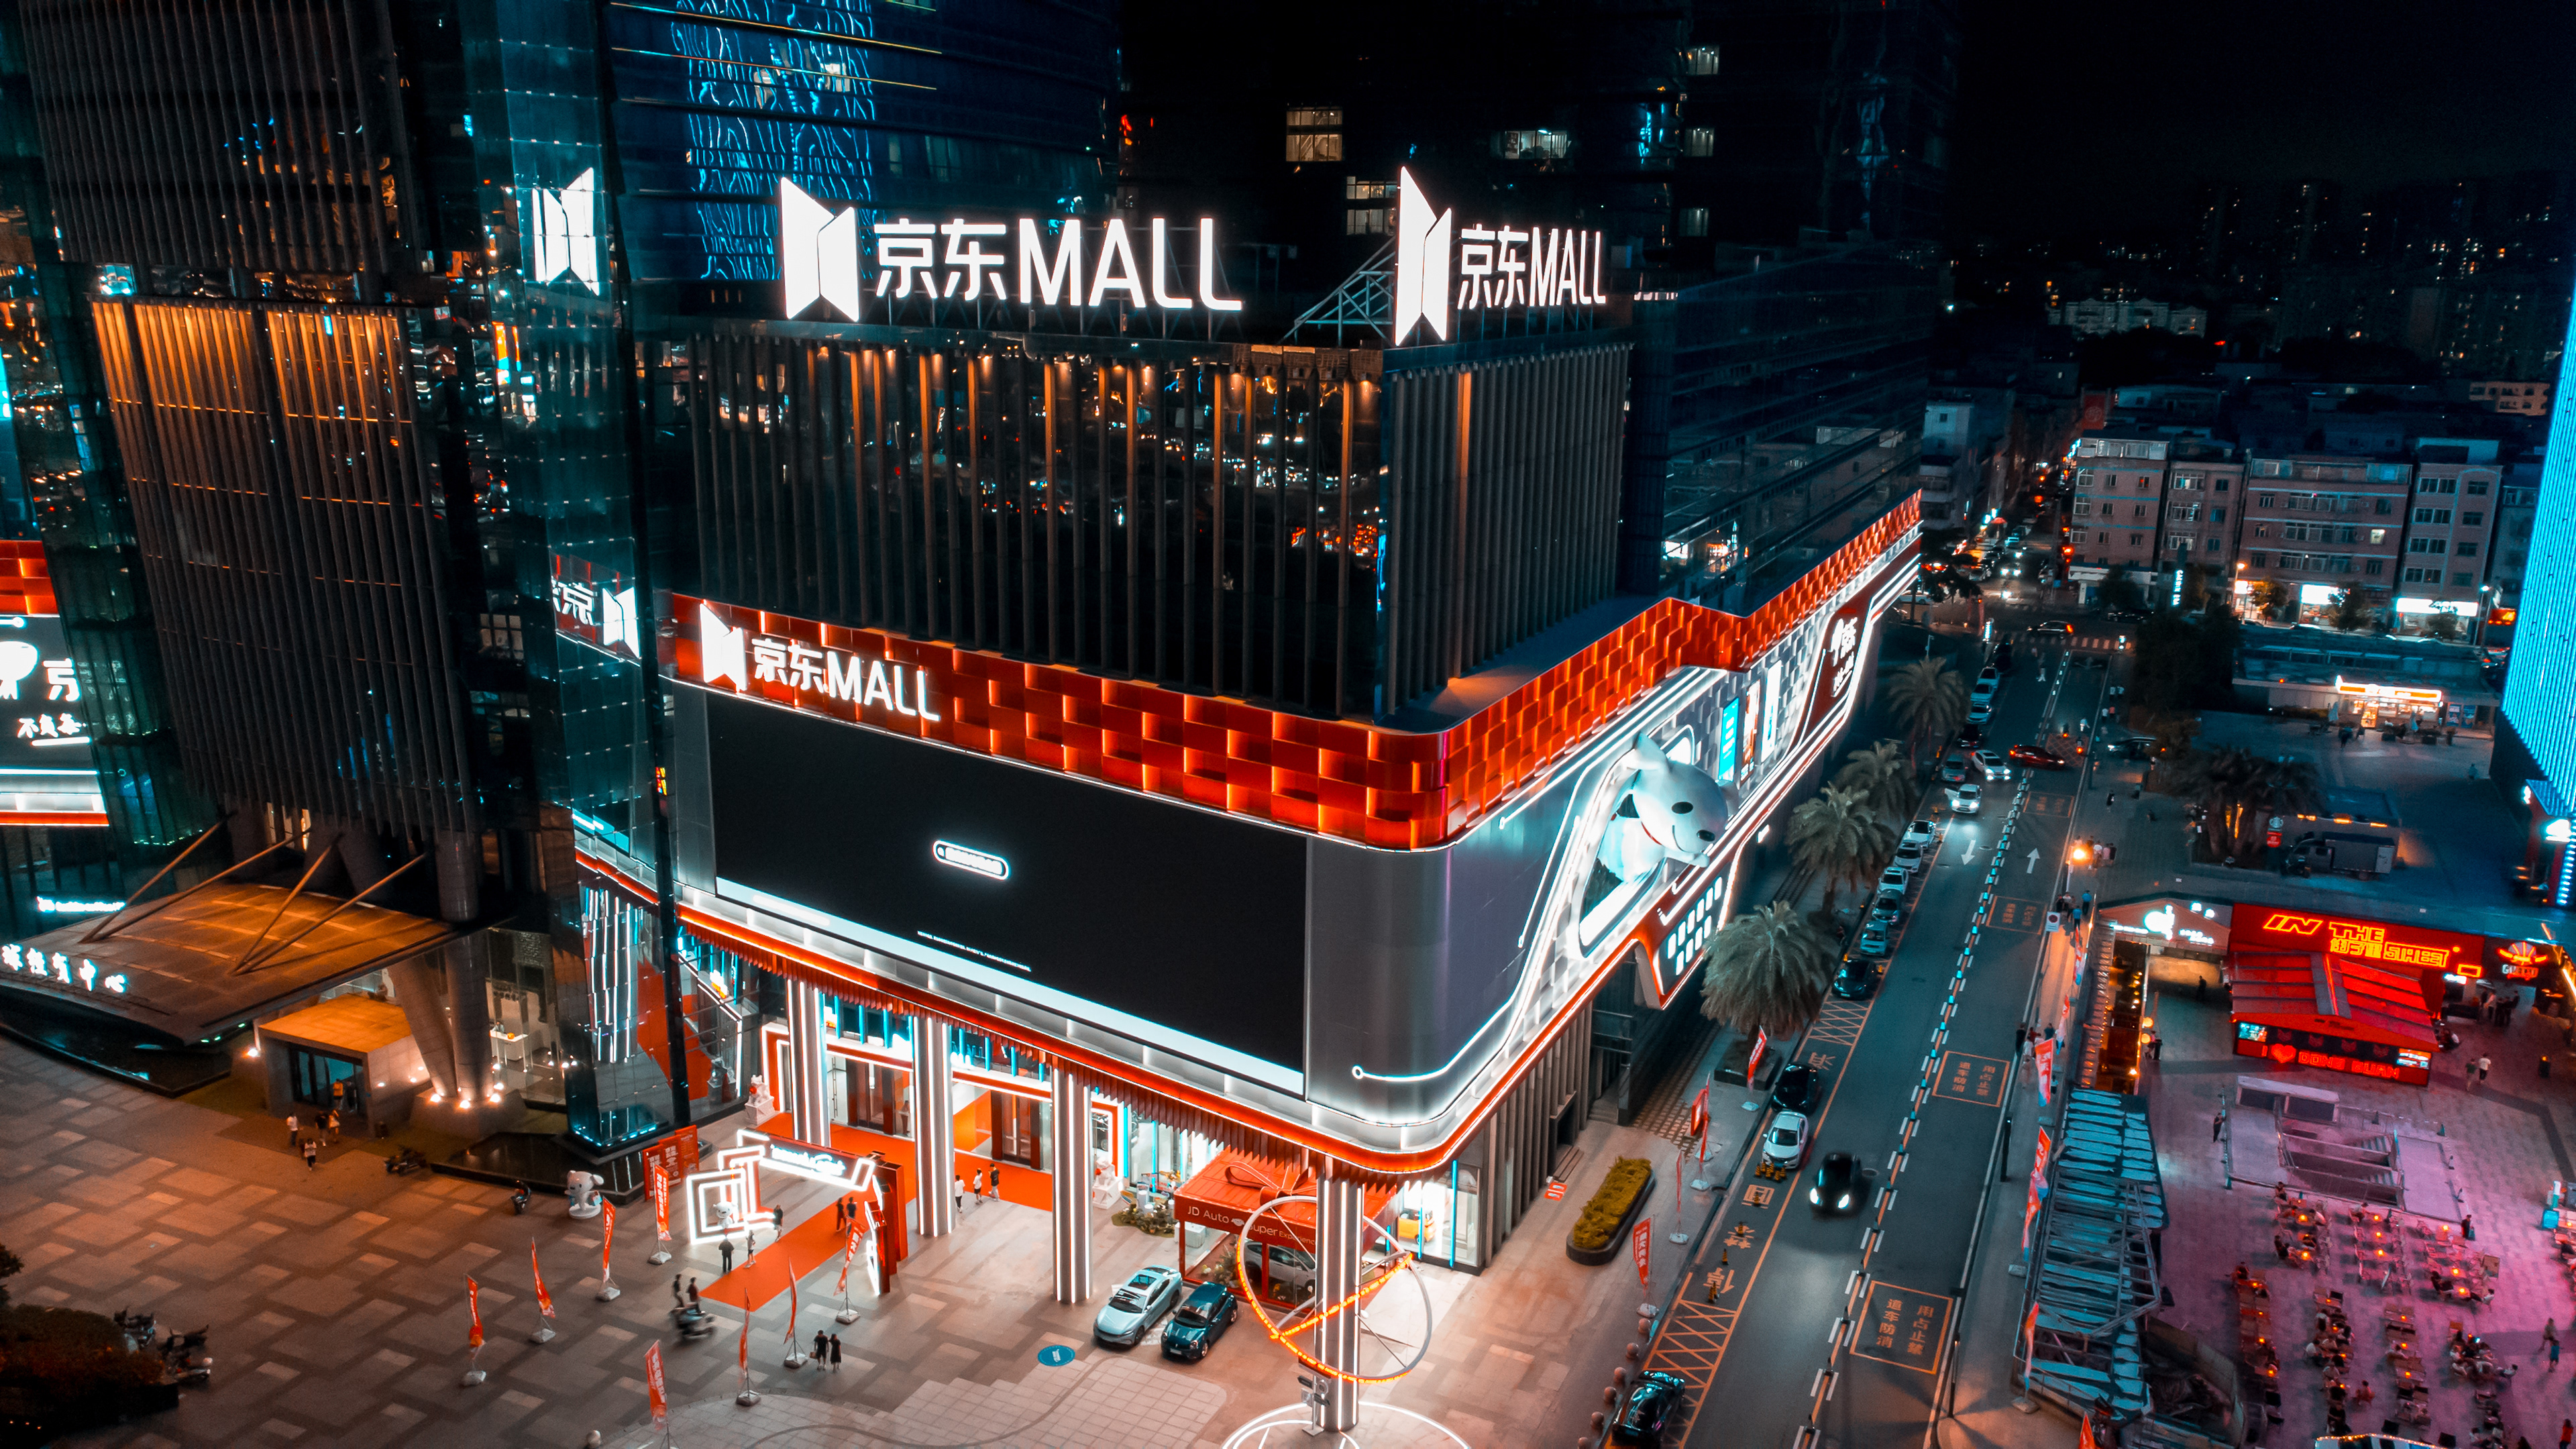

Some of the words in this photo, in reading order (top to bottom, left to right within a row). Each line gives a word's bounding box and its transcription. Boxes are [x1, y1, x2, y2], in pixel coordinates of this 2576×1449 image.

[874, 218, 1242, 311] 京东MALL
[1457, 223, 1607, 310] 京东MALL
[751, 637, 941, 722] 京东MALL
[2263, 914, 2323, 935] IN
[2328, 922, 2385, 944] THE
[1187, 1205, 1200, 1216] JD
[1203, 1210, 1230, 1224] Auto
